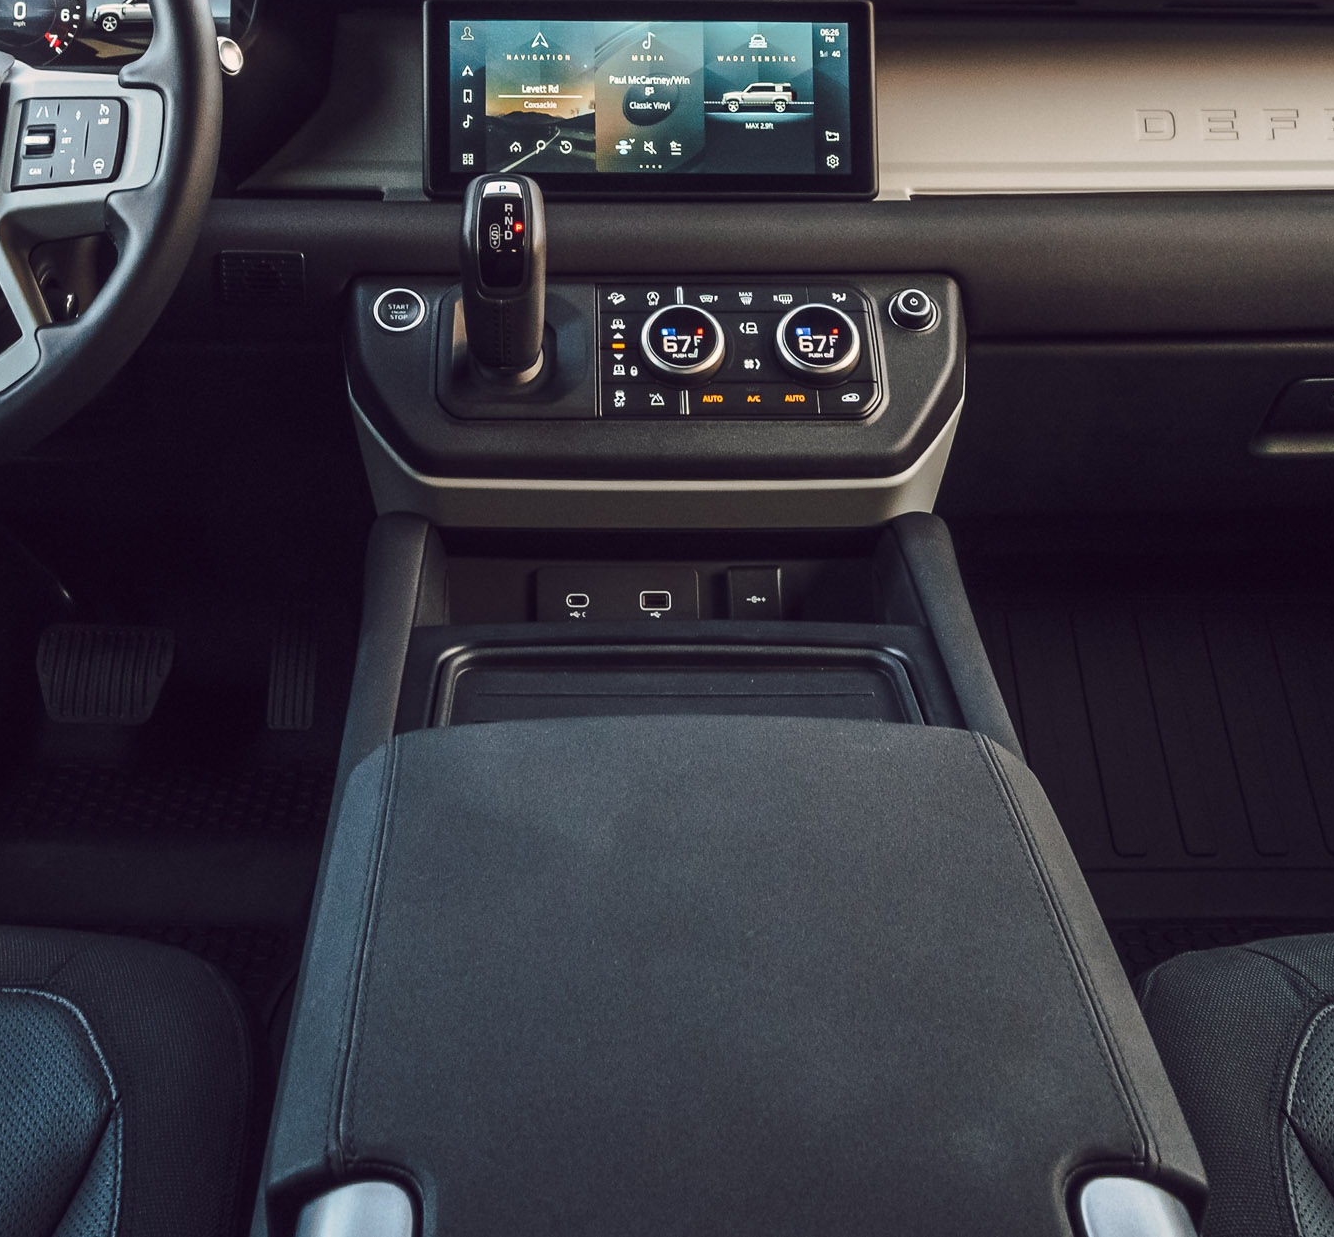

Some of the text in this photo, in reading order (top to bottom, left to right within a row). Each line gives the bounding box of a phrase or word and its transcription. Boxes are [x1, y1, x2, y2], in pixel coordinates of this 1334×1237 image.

[14, 2, 26, 20] 0
[61, 9, 70, 22] 6
[49, 35, 59, 48] 7
[609, 75, 691, 87] Paul McCartney/Win
[522, 85, 560, 94] Levett Rd
[645, 87, 655, 97] gs
[524, 101, 558, 109] Coxsackie
[629, 102, 671, 111] Classic Vinyl
[505, 204, 513, 212] R
[505, 217, 513, 225] N
[505, 231, 513, 240] D
[703, 395, 724, 403] AUTO
[747, 395, 761, 403] A/C
